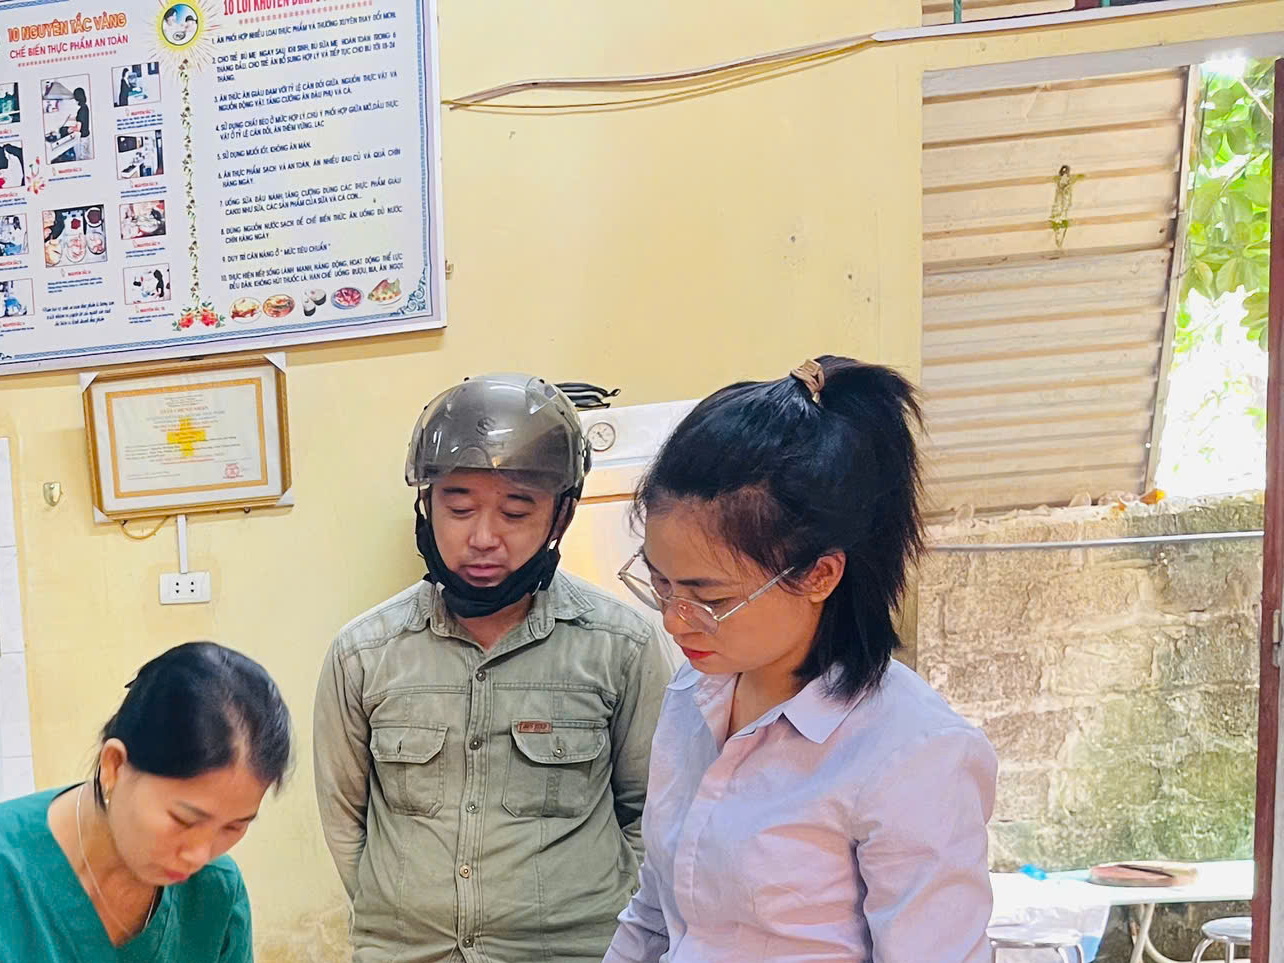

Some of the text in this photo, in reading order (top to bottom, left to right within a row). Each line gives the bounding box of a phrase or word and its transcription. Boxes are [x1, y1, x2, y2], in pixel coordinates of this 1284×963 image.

[8, 12, 127, 42] 10 NGUYÊN TẮC VÀNG
[10, 35, 128, 58] CHẾ BIẾN THỰC PHẨM AN TOÀN
